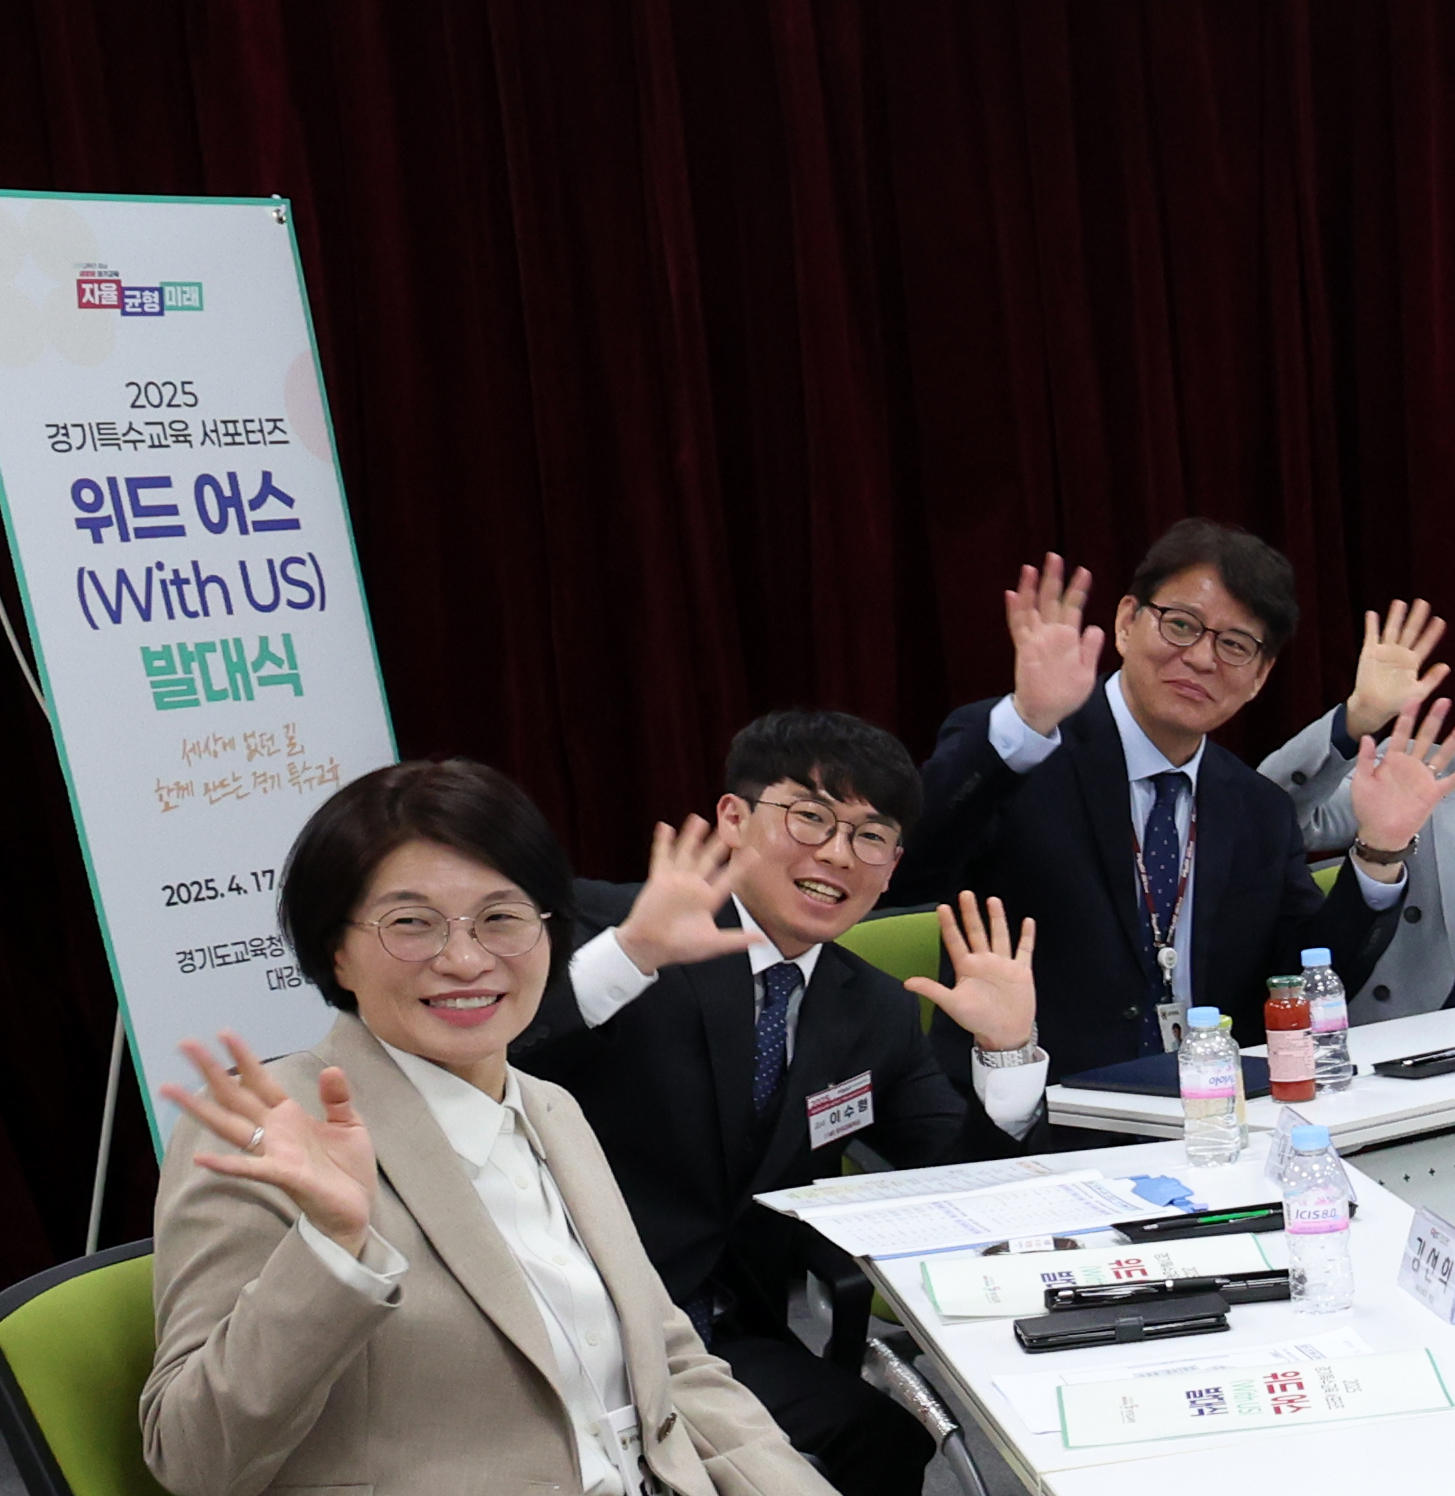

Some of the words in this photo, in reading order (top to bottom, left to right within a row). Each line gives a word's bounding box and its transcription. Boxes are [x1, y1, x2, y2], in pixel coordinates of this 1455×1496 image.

[81, 282, 118, 305] 자율
[124, 289, 160, 313] 균형
[165, 285, 200, 307] 미래
[125, 381, 199, 409] 2025
[45, 420, 193, 453] 경기특수교육
[200, 418, 290, 448] 서포터즈
[70, 475, 187, 544] 위드
[193, 470, 302, 536] 어스
[77, 560, 235, 630] (With
[238, 552, 327, 614] US)
[140, 632, 305, 711] 발대식
[181, 733, 236, 767] 세상에
[154, 778, 195, 813] 함께
[203, 771, 251, 805] 만드는
[252, 770, 281, 794] 경기
[287, 756, 341, 795] 특수교육
[161, 878, 225, 907] 2025.
[228, 875, 248, 895] 4.
[176, 934, 286, 973] 경기도교육청
[1263, 1371, 1305, 1394] 위드
[1185, 1386, 1229, 1418] 발대식
[1271, 1394, 1312, 1415] 어스
